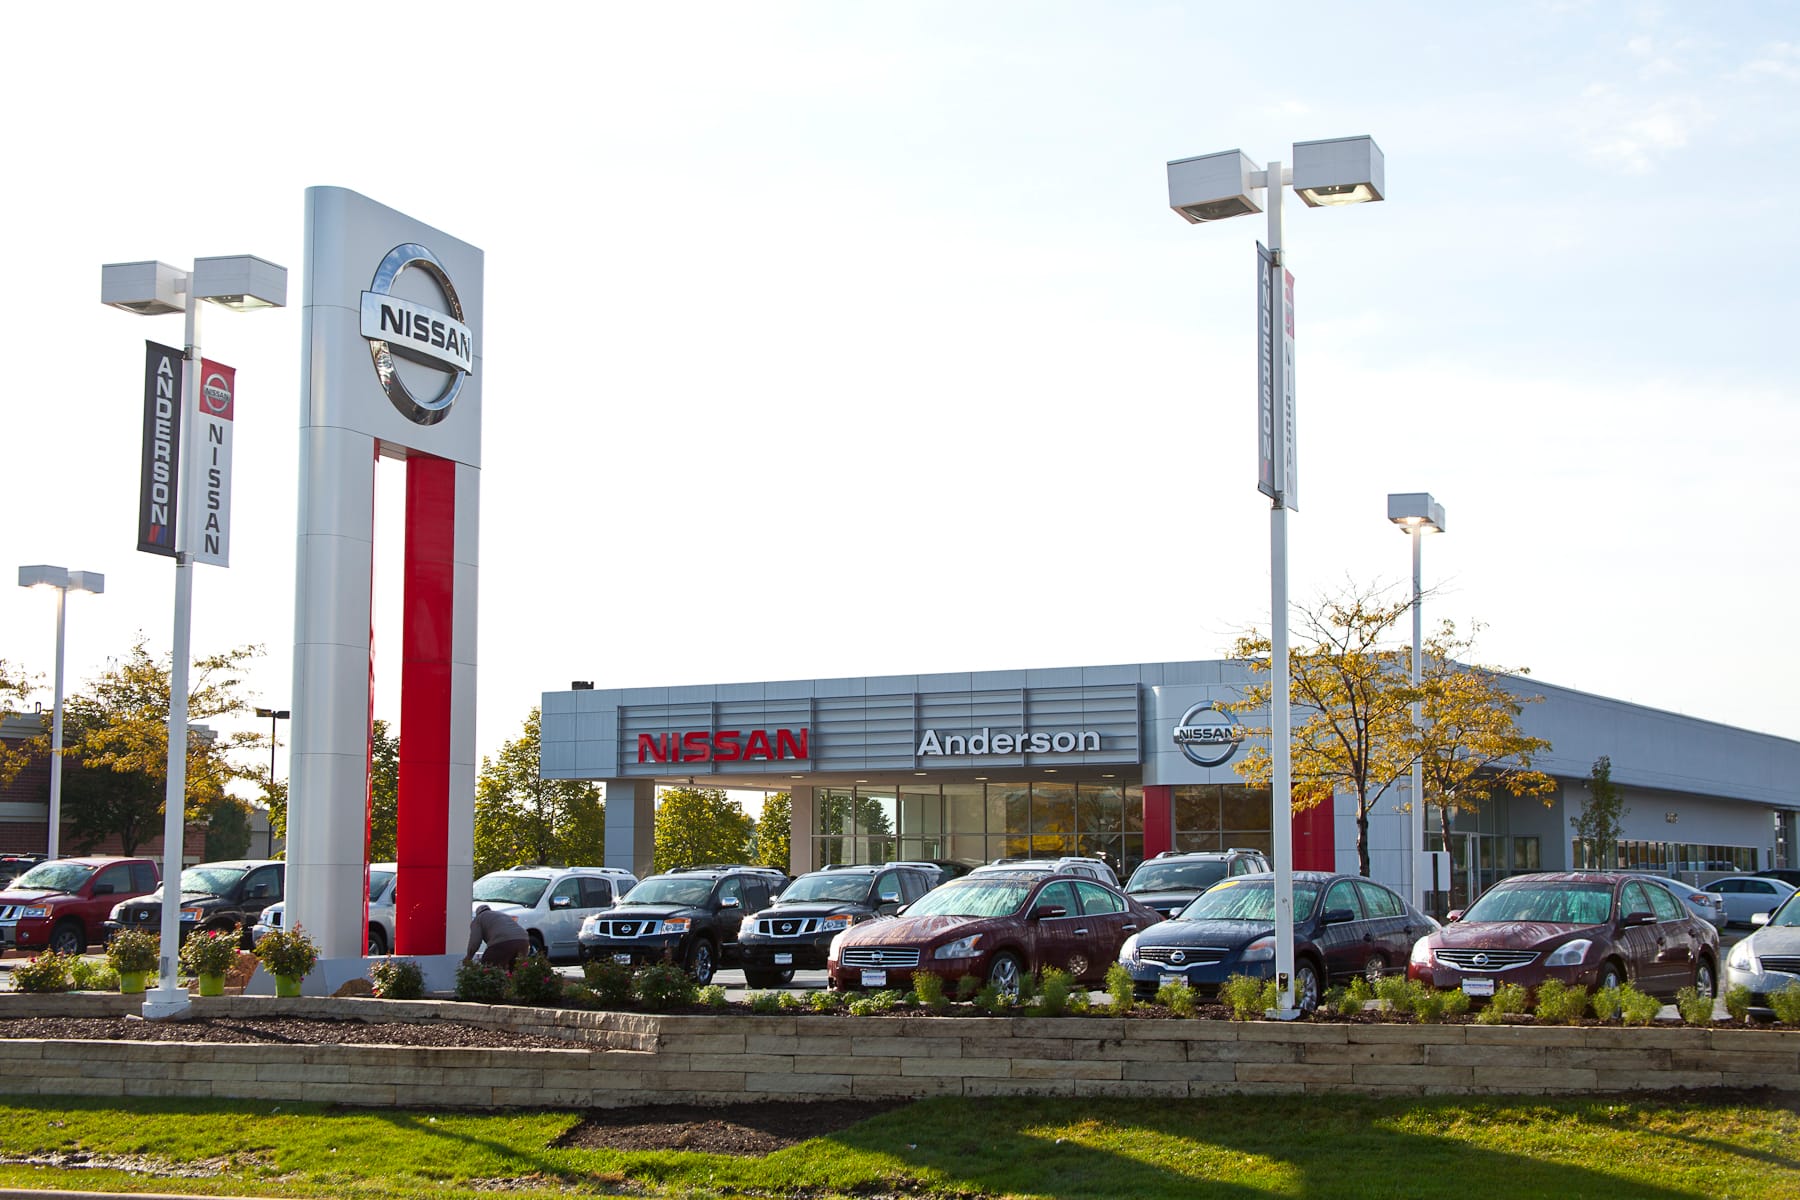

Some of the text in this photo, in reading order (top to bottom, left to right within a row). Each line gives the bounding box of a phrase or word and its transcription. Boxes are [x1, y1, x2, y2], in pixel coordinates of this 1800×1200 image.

[381, 304, 471, 361] NISSAN
[1262, 261, 1271, 460] ANDERSON
[151, 356, 174, 526] ANDERSON
[205, 422, 223, 555] NISSAN
[639, 728, 809, 763] NISSAN
[917, 728, 1102, 756] Anderson
[1180, 728, 1234, 739] NISSAN
